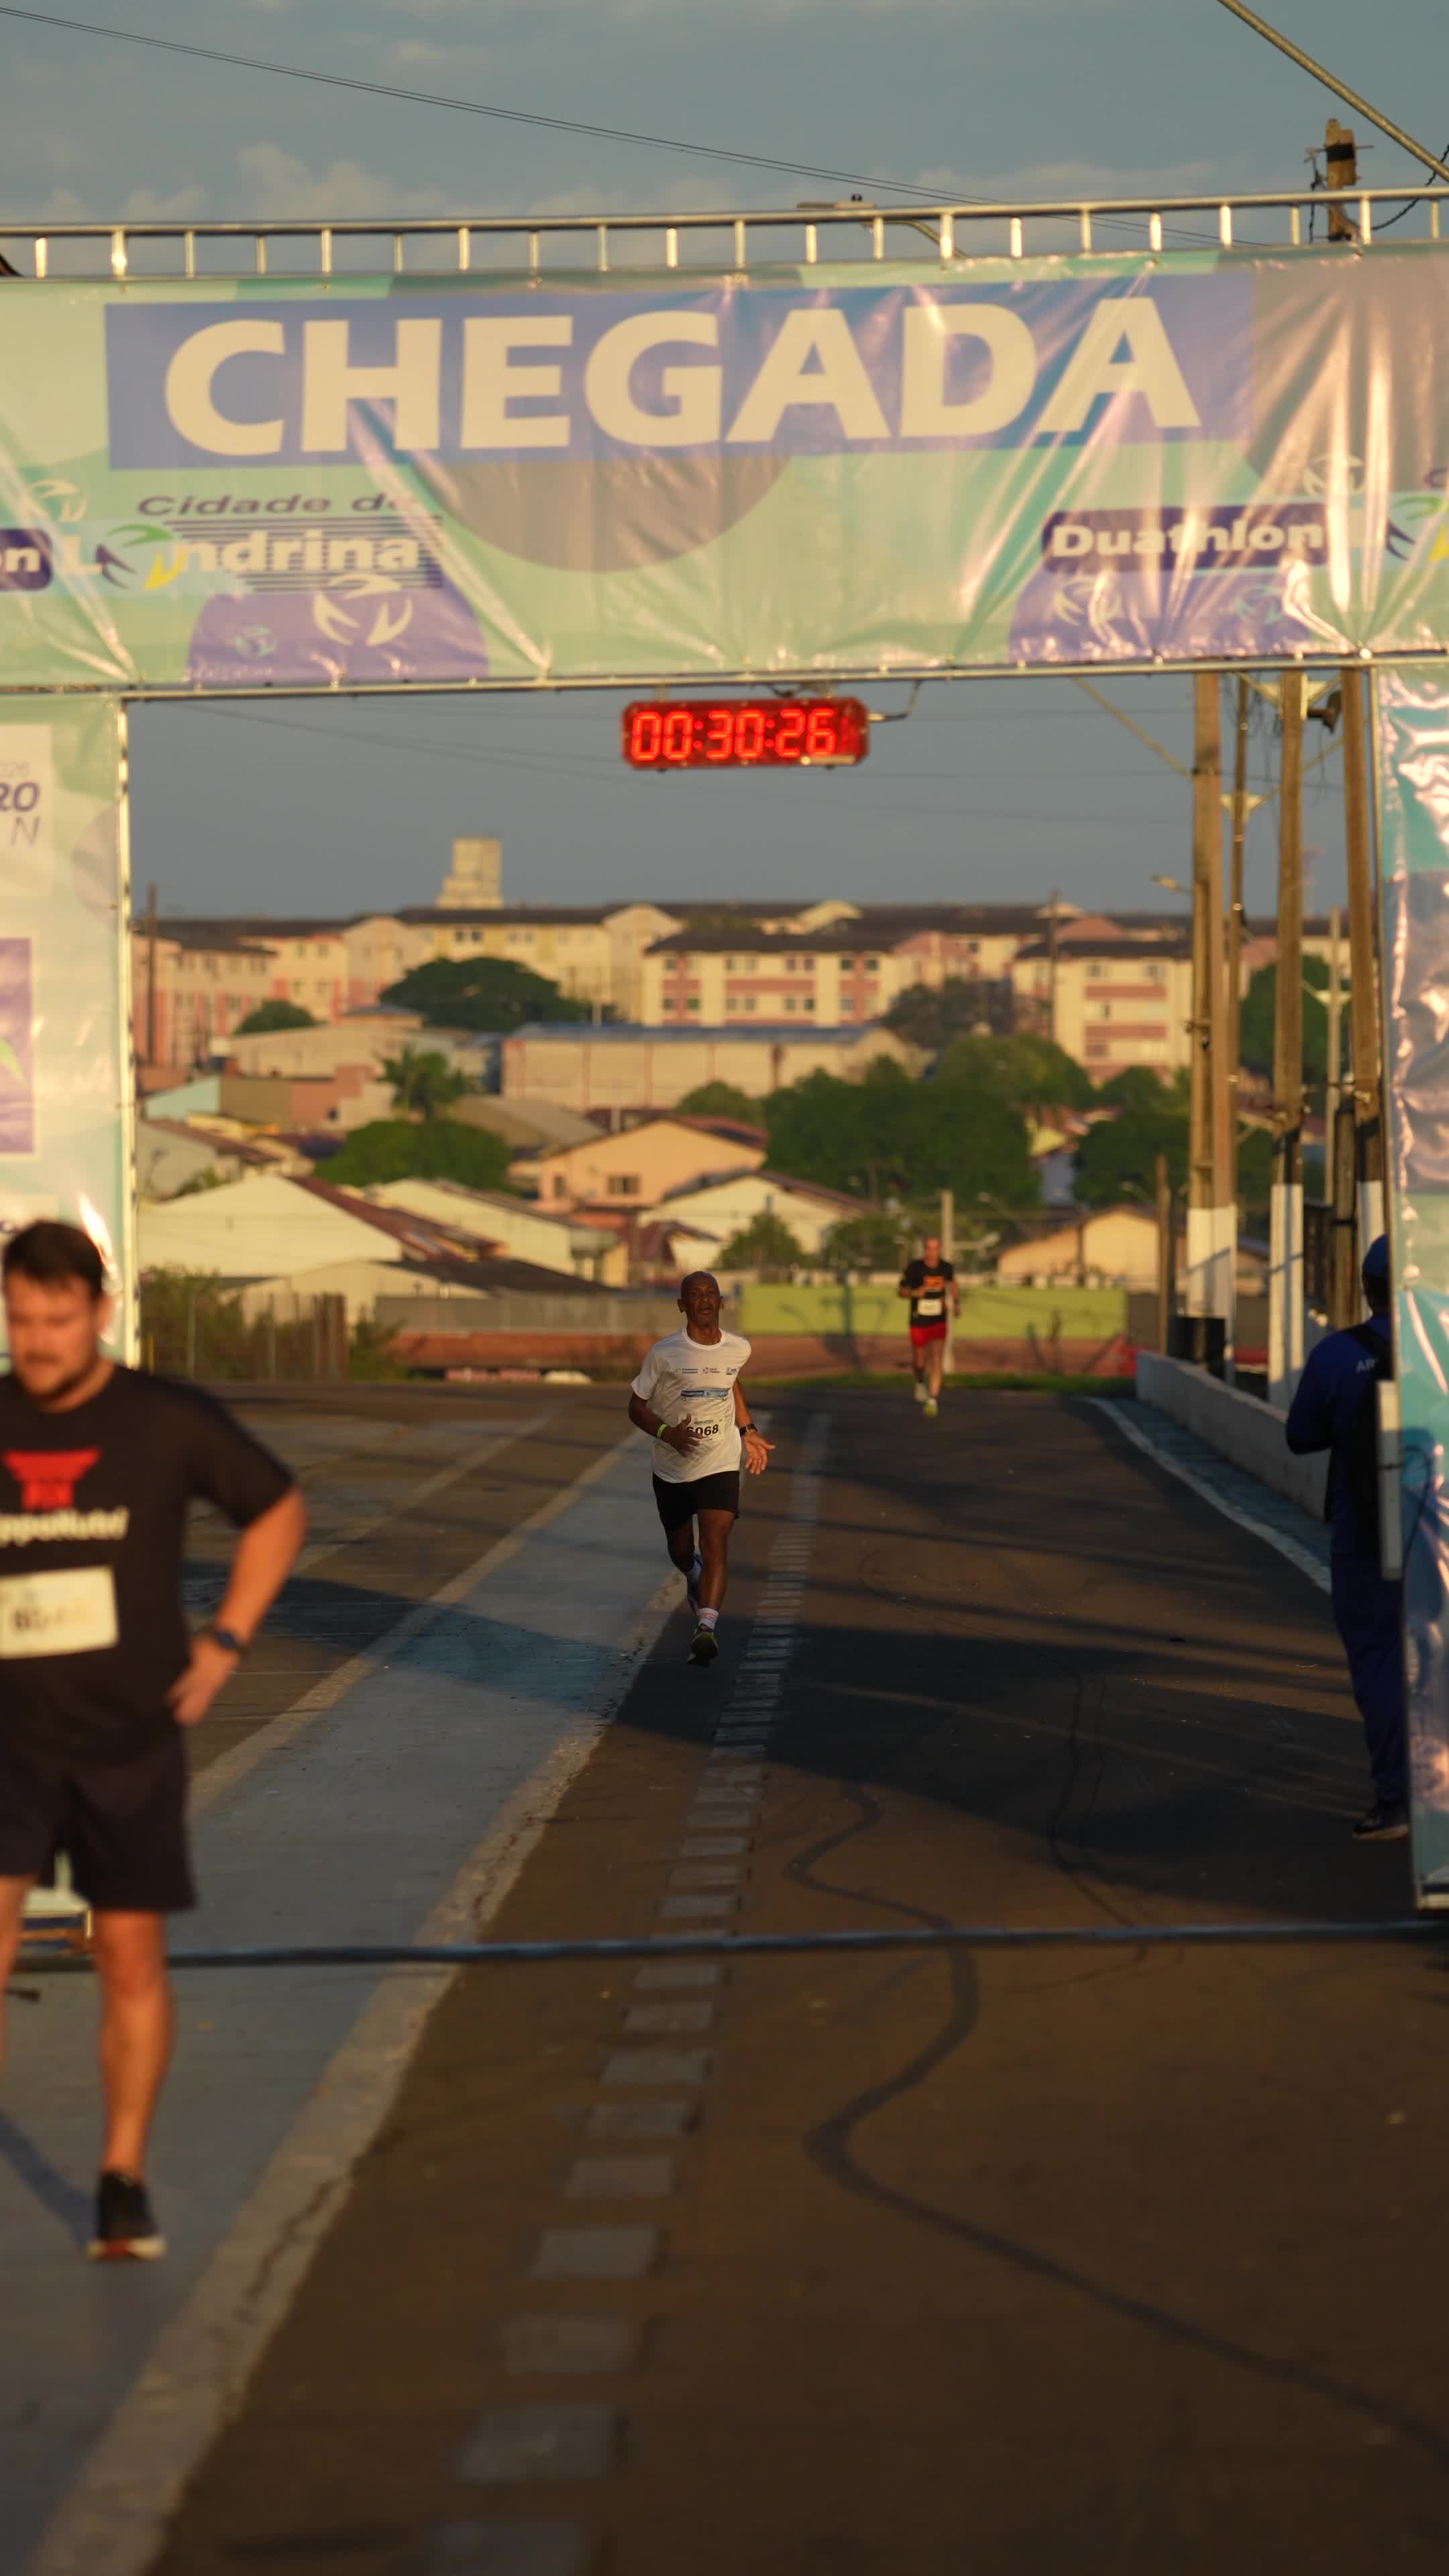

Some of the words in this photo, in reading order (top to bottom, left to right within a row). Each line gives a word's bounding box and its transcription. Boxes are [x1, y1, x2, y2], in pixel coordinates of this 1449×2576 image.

[165, 296, 1201, 456] CHEGADA
[137, 493, 331, 516] Cidade
[1052, 520, 1324, 557] Duathlon
[631, 708, 836, 761] 00:30:26
